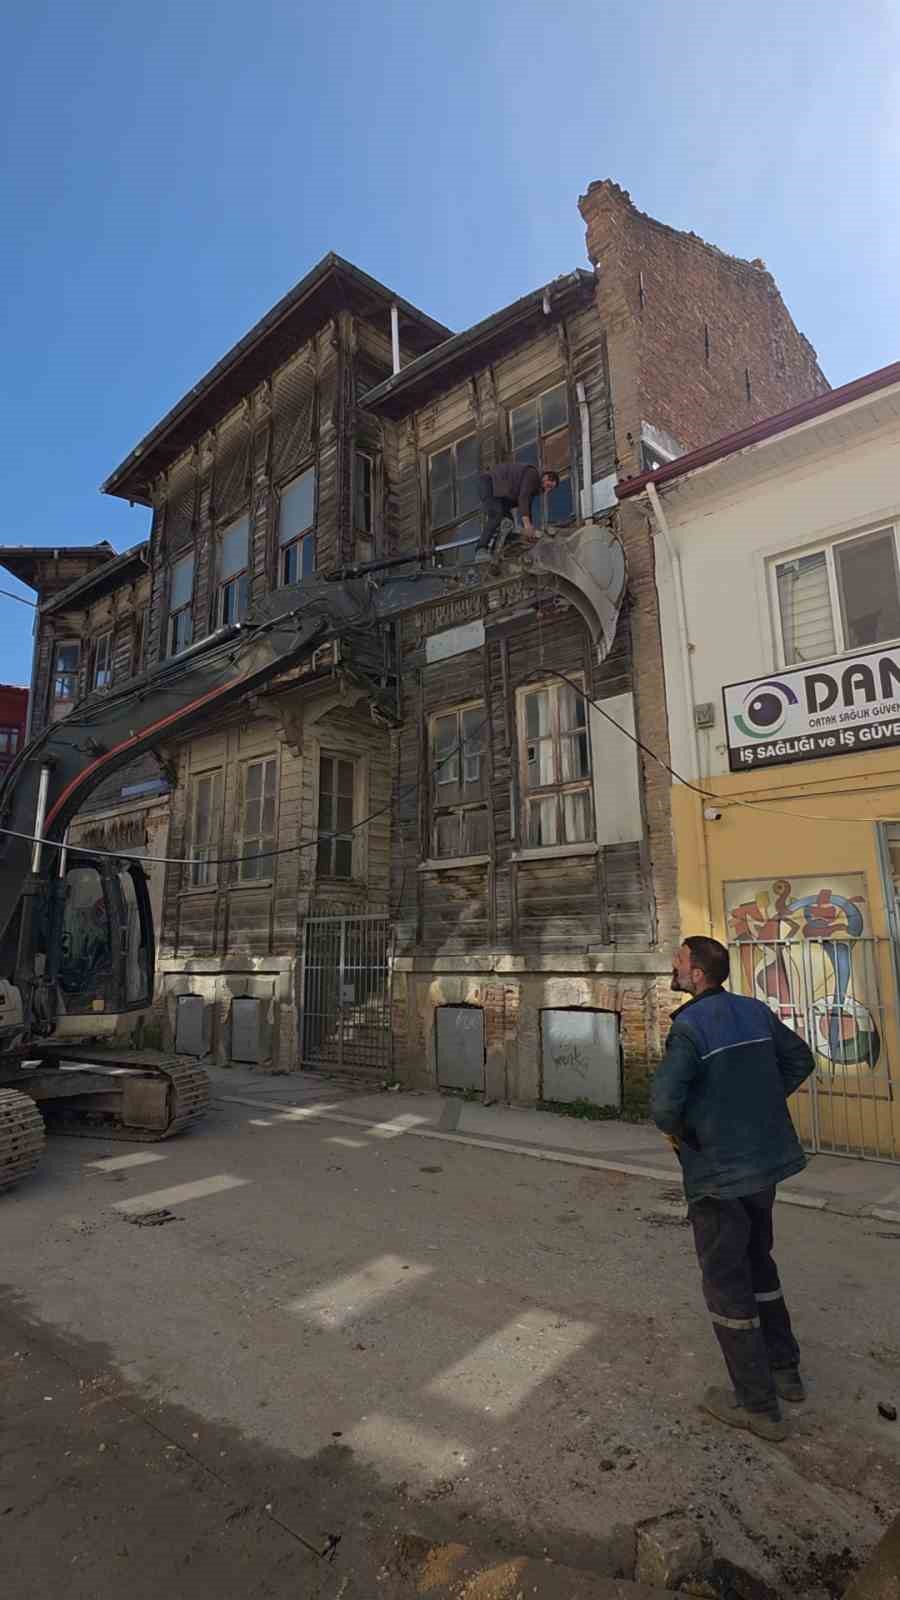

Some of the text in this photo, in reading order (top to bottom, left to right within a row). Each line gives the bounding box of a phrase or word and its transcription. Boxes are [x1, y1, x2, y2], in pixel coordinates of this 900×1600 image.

[808, 714, 837, 728] ORTAK
[839, 707, 870, 723] SAĞLIK
[739, 748, 753, 763] İŞ
[756, 737, 815, 759] SAĞLIĞI
[817, 738, 836, 748] ve
[839, 730, 856, 747] İŞ
